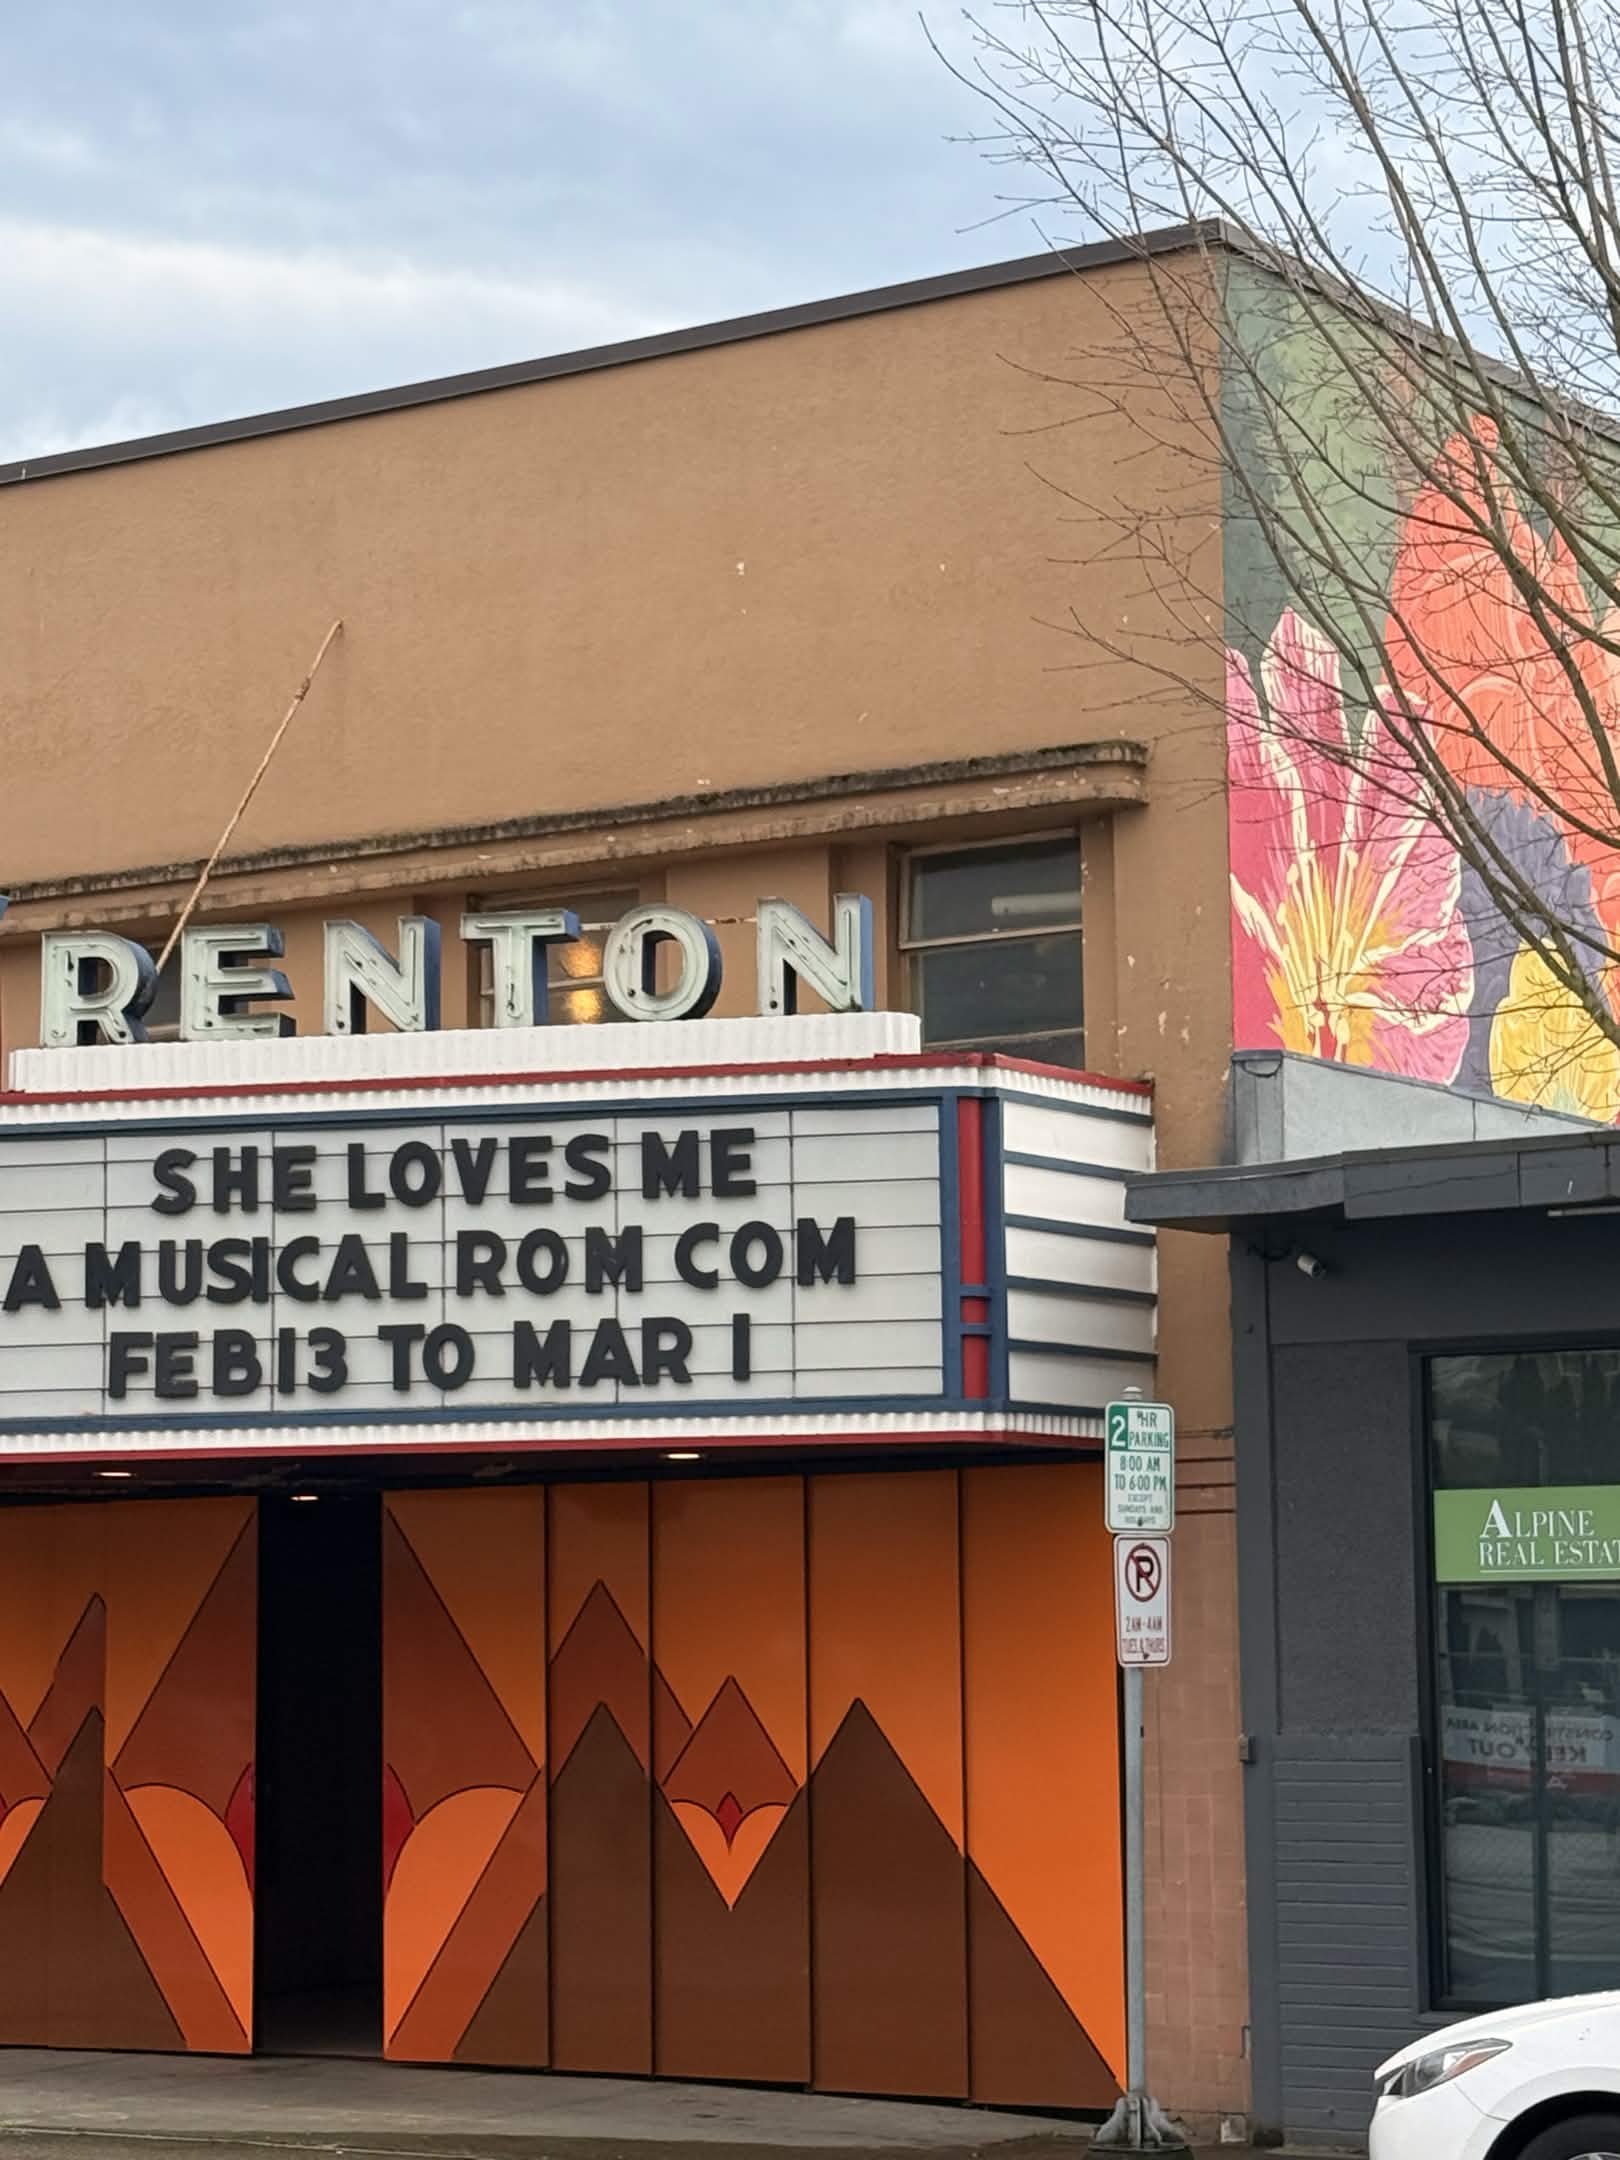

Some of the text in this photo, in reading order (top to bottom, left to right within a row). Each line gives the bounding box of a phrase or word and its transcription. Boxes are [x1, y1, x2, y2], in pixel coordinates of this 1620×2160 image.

[41, 892, 873, 1048] RENTON
[152, 1127, 757, 1215] SHE LOVES ME
[2, 1216, 856, 1311] A MUSICAL ROM COM
[378, 1322, 476, 1392] TO
[513, 1315, 693, 1389] MAR
[1111, 1412, 1157, 1447] 2 HR
[1129, 1431, 1169, 1449] PARKING
[1146, 1456, 1161, 1472] AM
[1115, 1474, 1126, 1490] TO
[1153, 1476, 1167, 1492] PM
[1480, 1499, 1595, 1539] ALPINE
[1480, 1541, 1544, 1567] REAL
